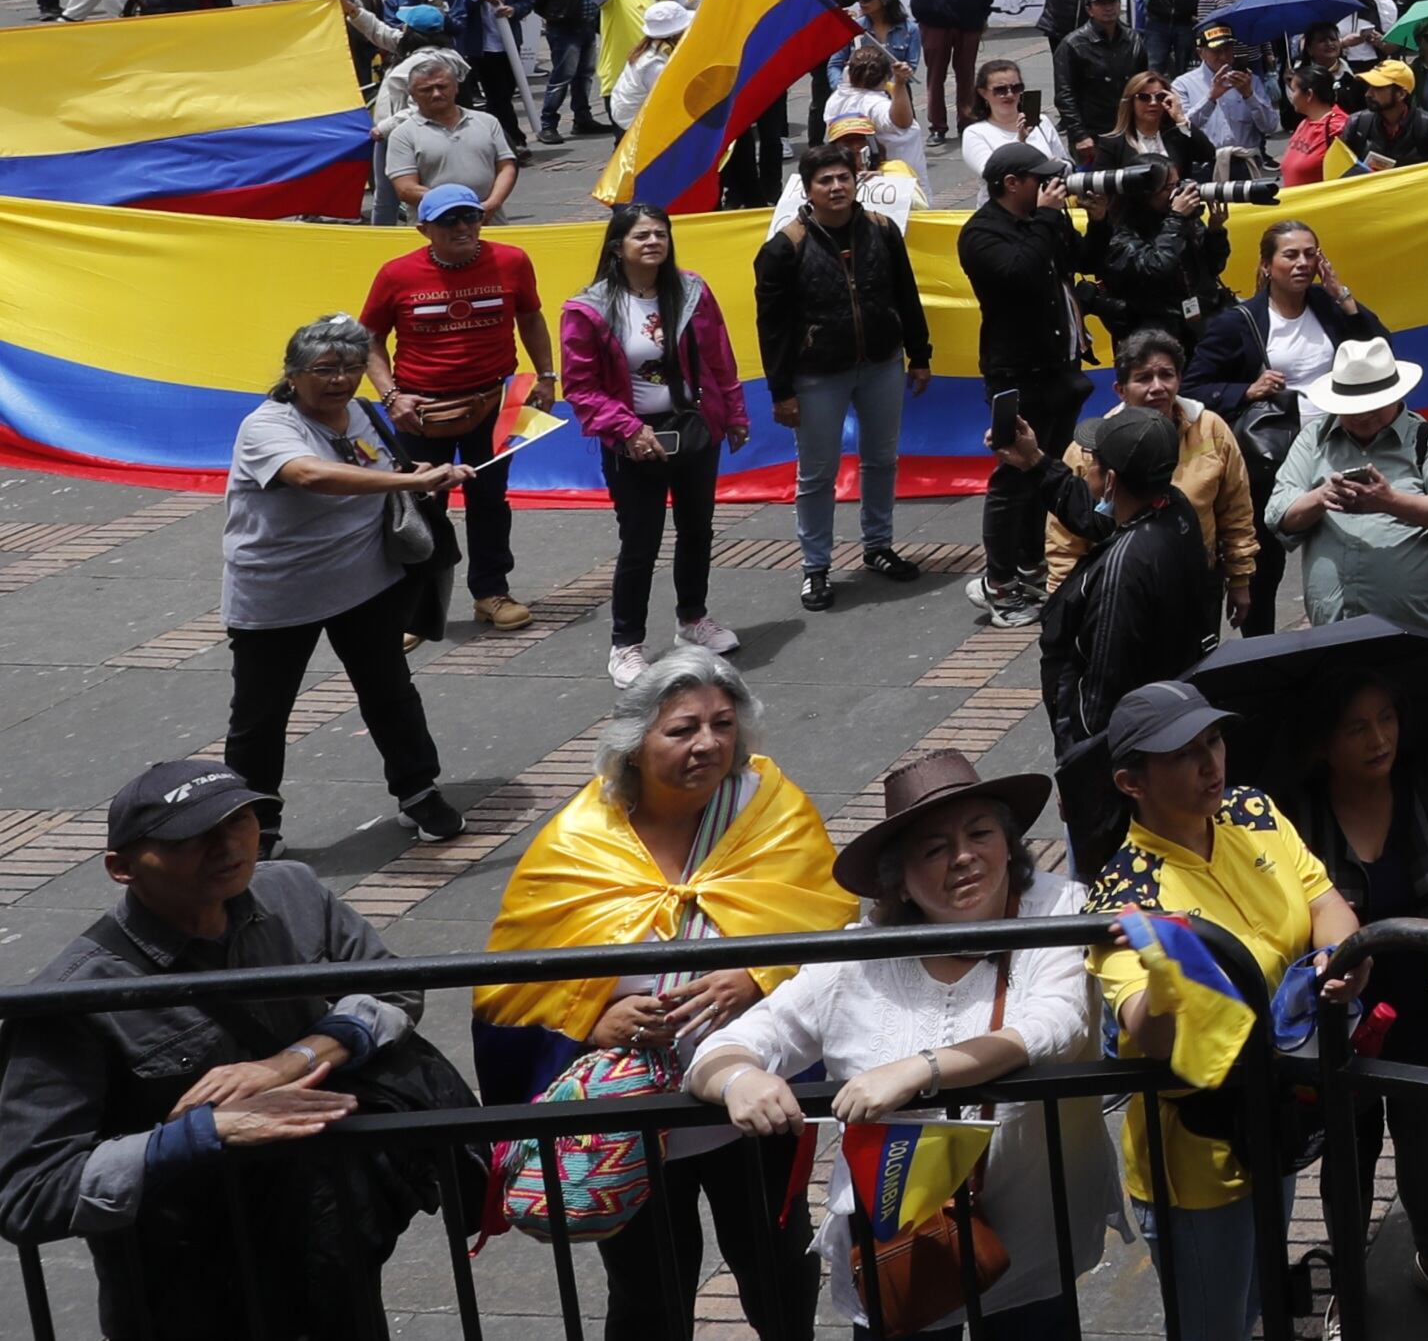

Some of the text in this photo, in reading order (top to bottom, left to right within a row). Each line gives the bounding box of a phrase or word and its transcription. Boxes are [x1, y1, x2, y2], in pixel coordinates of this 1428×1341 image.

[410, 284, 504, 303] TOMMY HILFIGER
[880, 1139, 910, 1223] COLOMBIA
